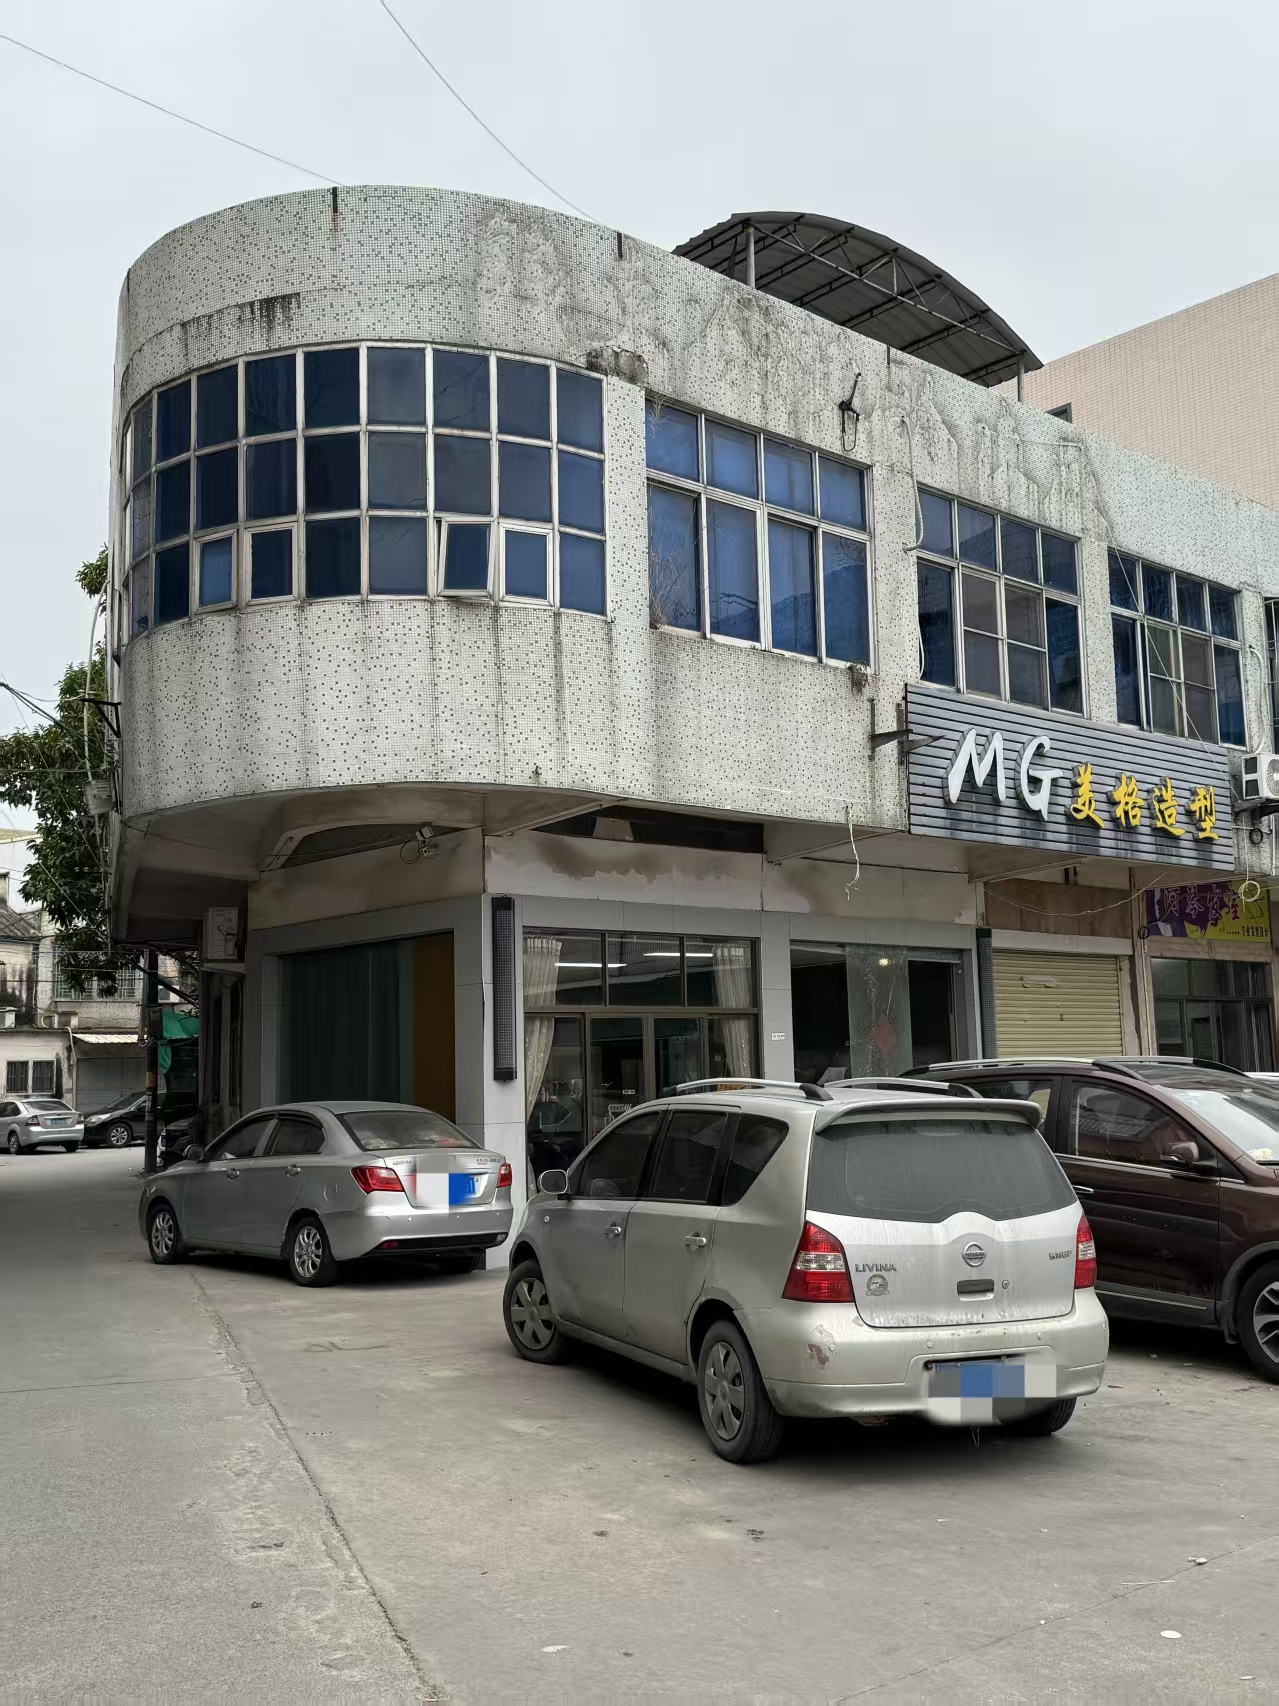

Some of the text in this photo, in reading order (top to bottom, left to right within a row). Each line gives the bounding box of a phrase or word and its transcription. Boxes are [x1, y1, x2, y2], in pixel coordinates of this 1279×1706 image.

[946, 728, 1219, 841] MG 美格造型
[854, 1263, 898, 1273] LIVINA
